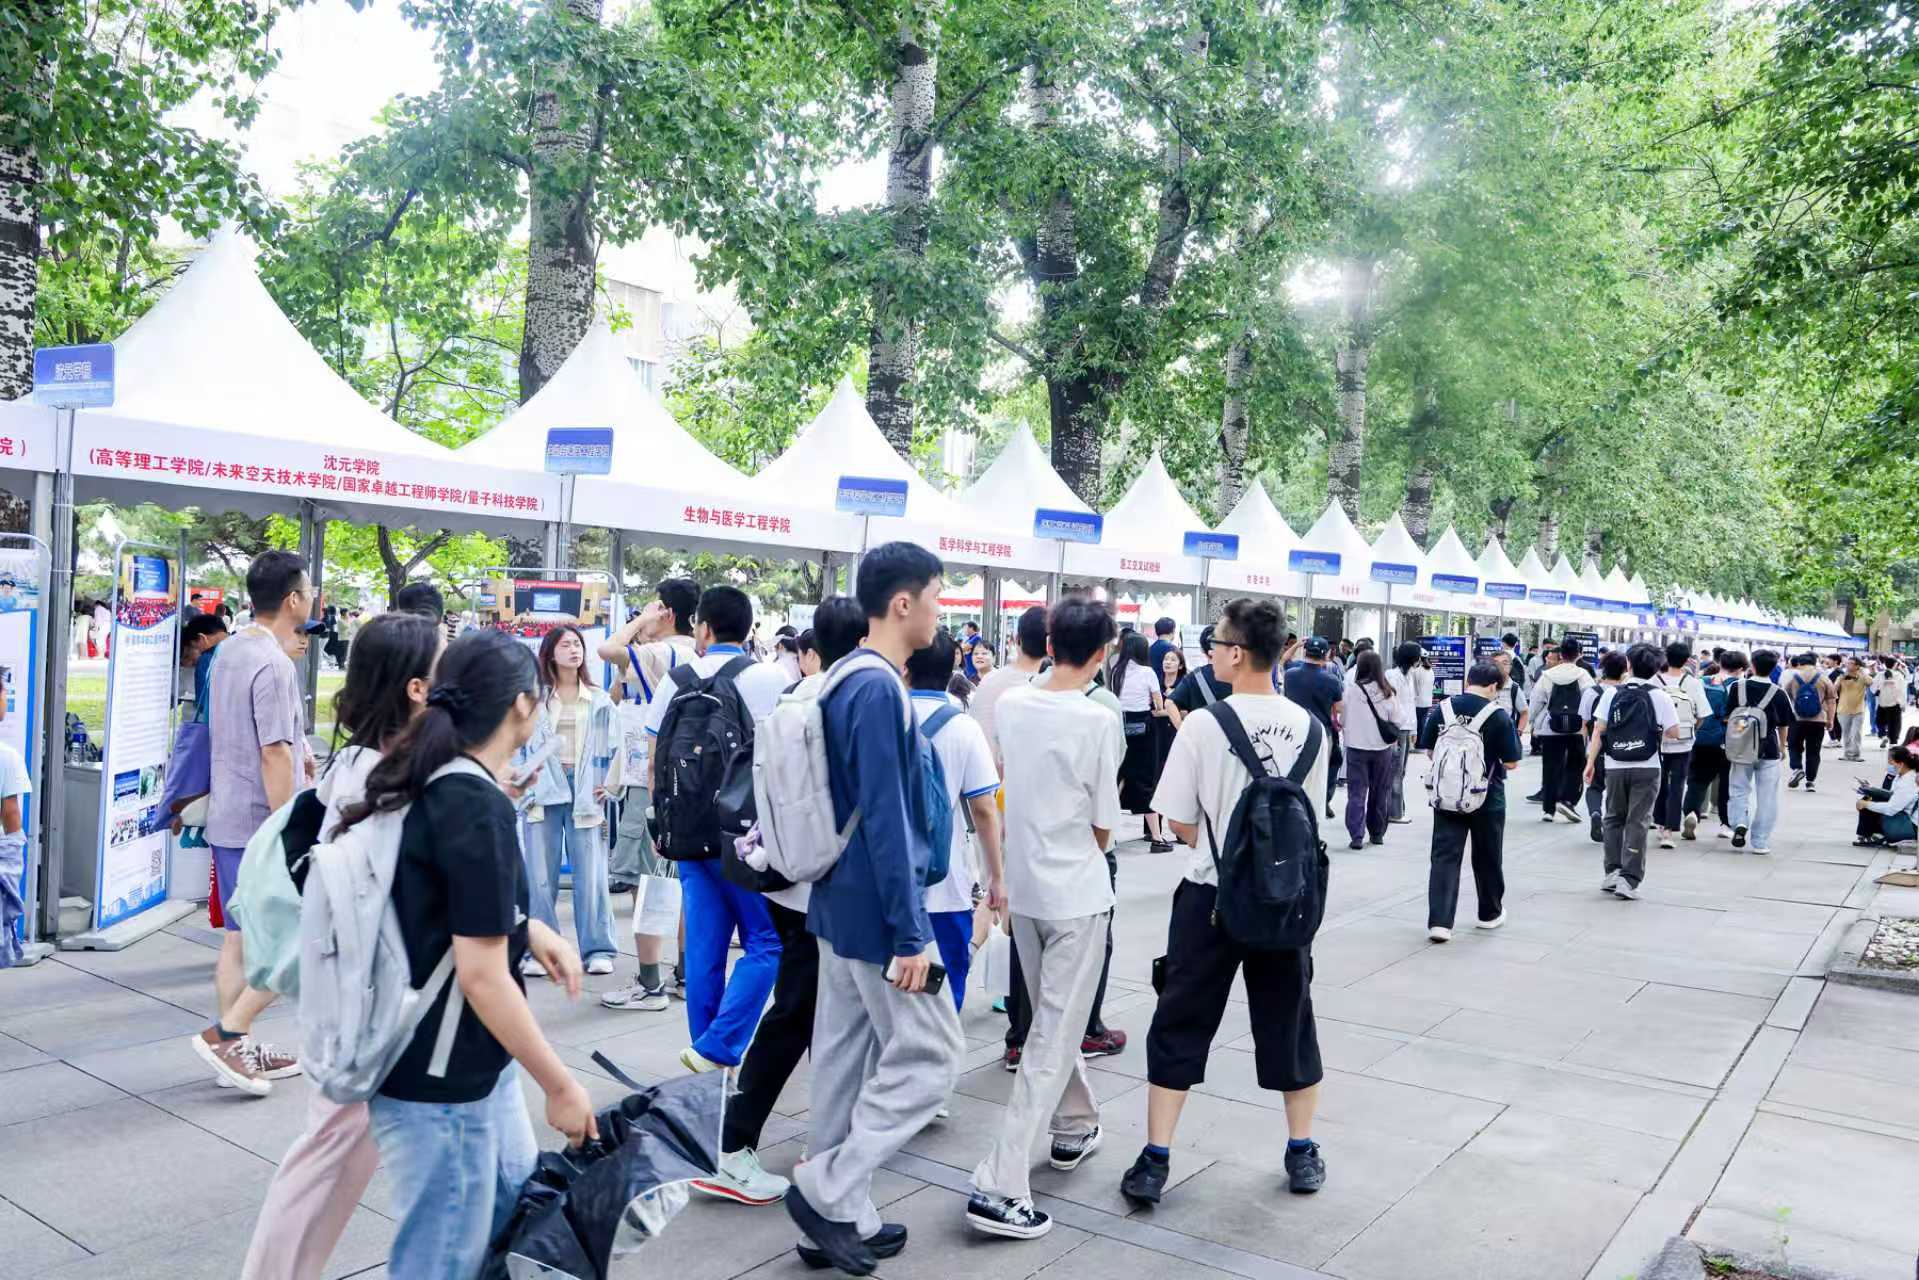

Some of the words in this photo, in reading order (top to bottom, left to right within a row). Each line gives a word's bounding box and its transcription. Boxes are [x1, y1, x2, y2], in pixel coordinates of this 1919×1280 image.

[323, 454, 381, 476] 沈元学院
[683, 505, 791, 534] 生物与医学工程学院
[939, 536, 1012, 558] 医学科学与工程学院
[1257, 722, 1294, 743] with
